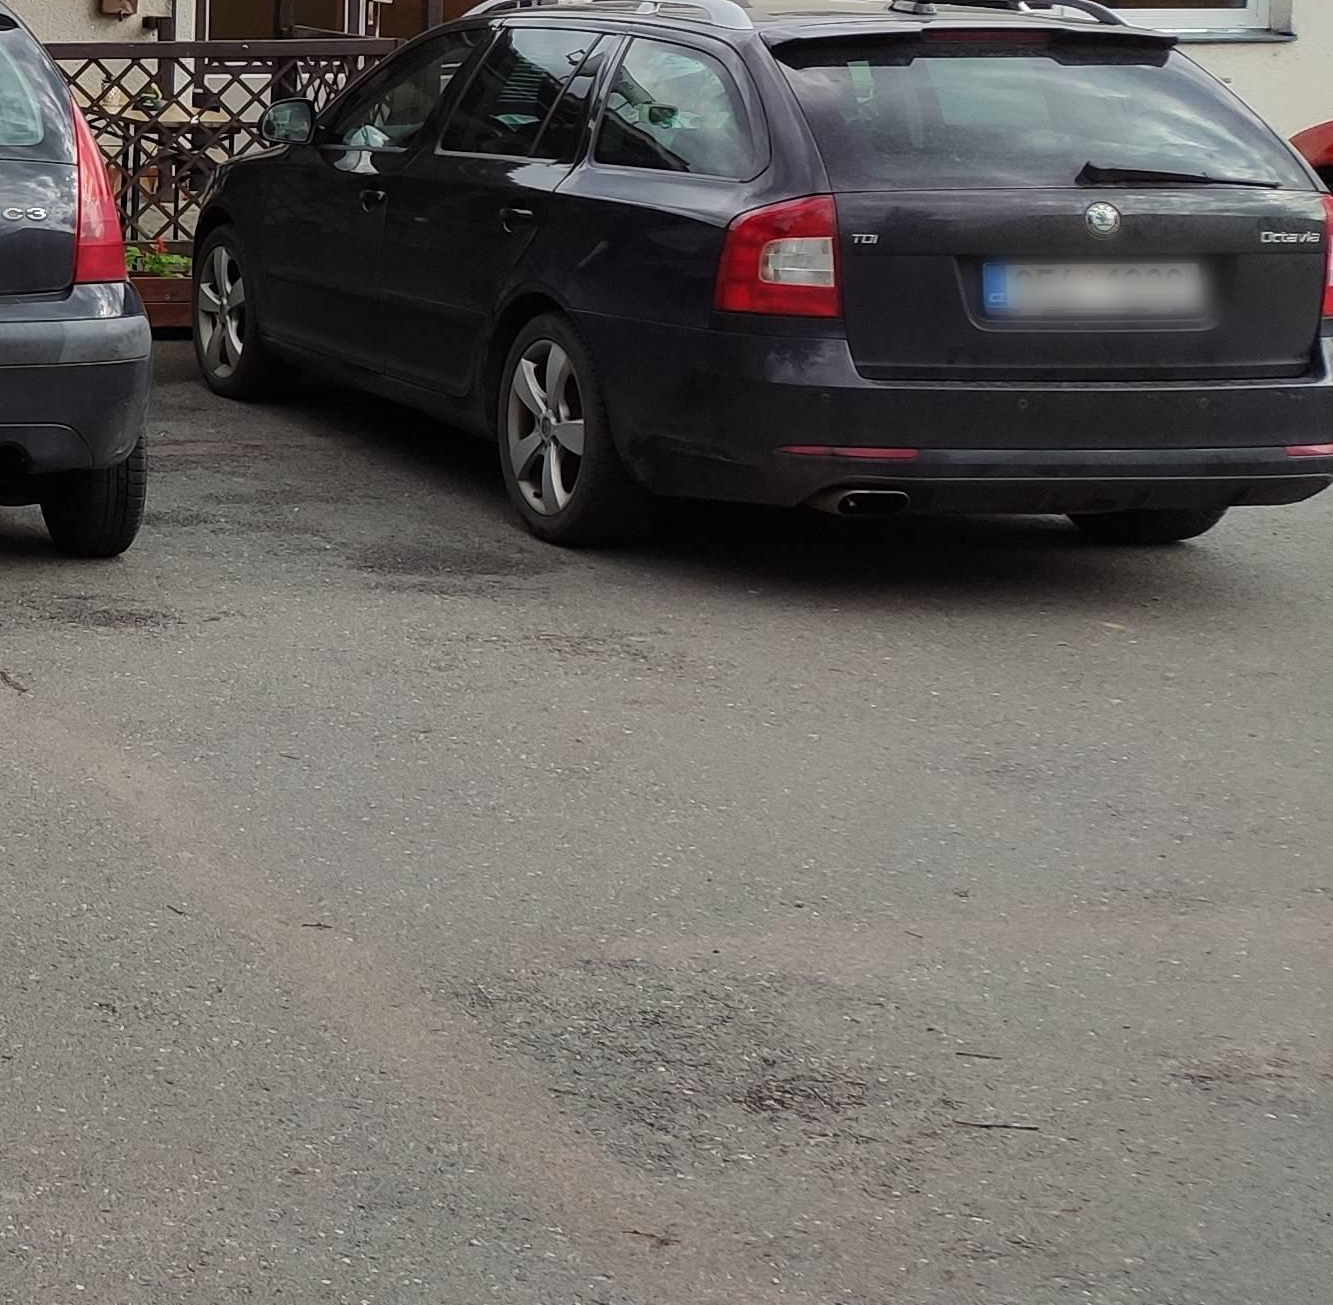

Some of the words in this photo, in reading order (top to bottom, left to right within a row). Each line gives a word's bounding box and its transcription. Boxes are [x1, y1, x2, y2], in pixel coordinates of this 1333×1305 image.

[3, 207, 47, 220] C3
[851, 233, 879, 244] TDI
[1260, 231, 1321, 243] Octavia
[988, 292, 1006, 303] CZ
